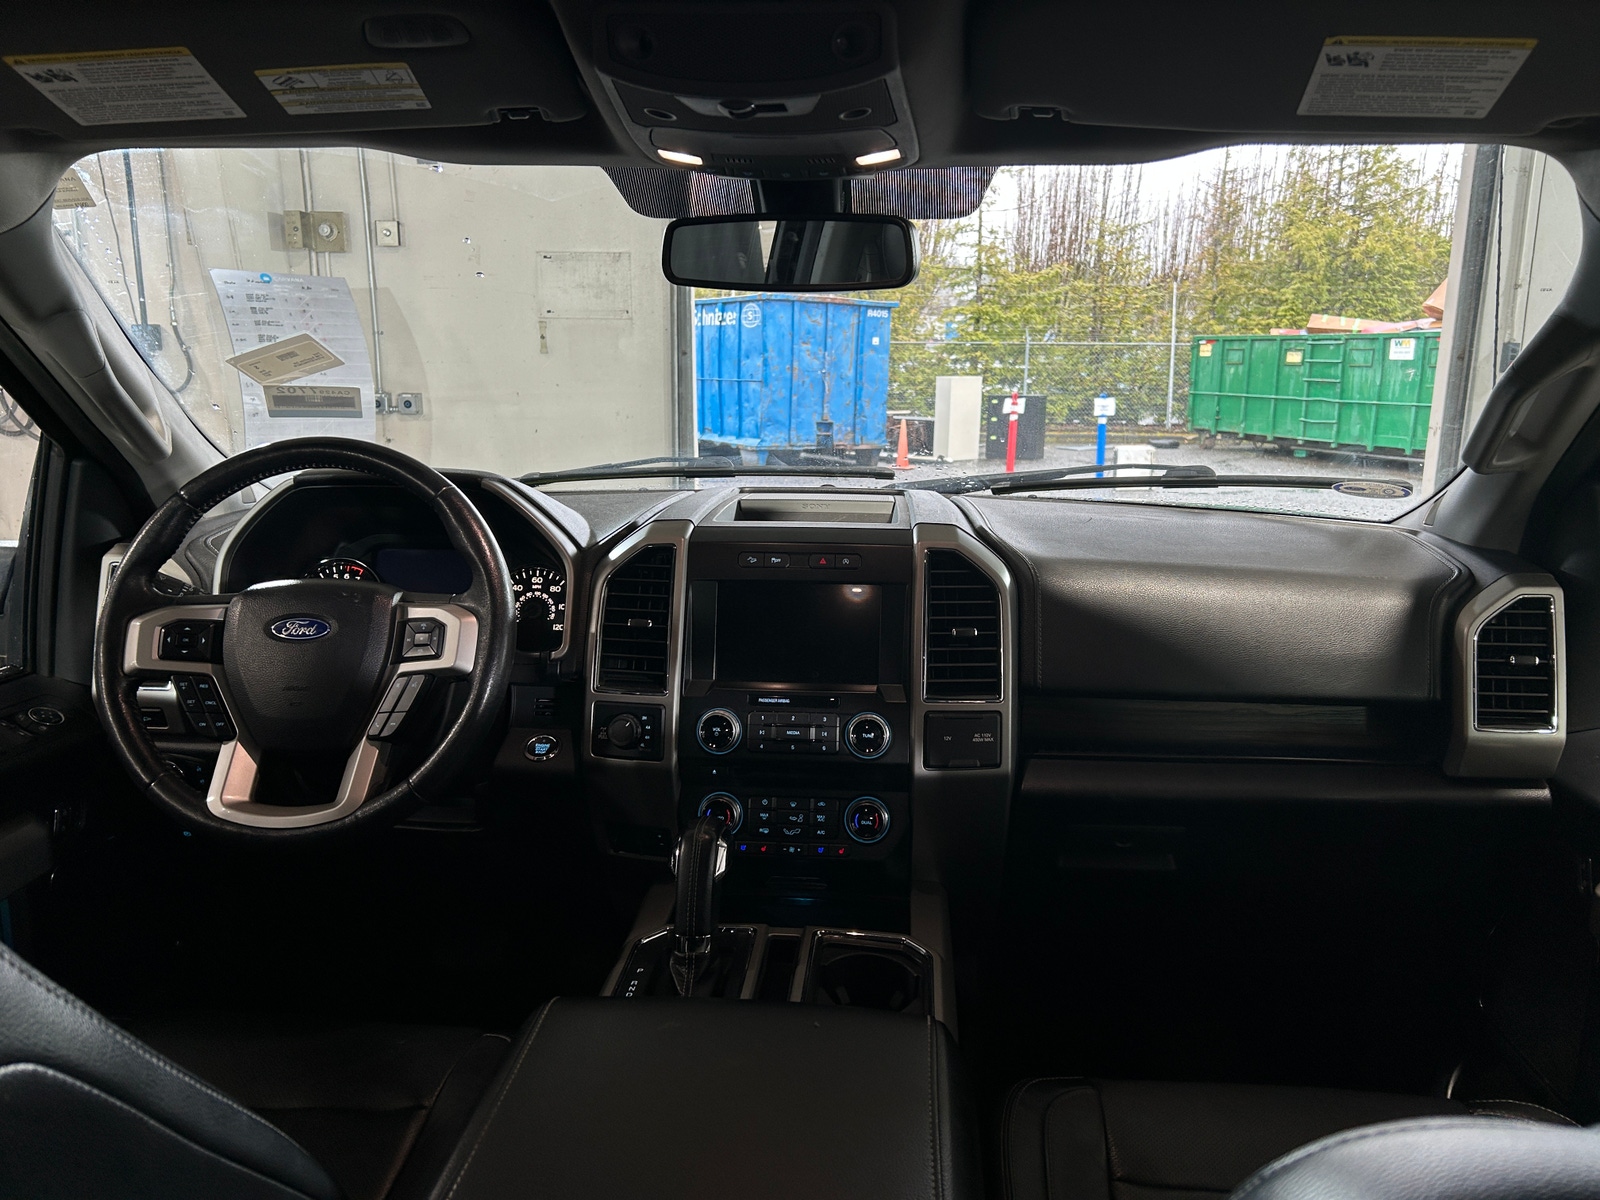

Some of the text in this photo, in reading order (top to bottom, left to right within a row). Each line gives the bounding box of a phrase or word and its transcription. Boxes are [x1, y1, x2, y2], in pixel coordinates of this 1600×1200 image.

[1394, 339, 1411, 347] WM
[531, 576, 544, 584] 60
[282, 620, 317, 635] Ford
